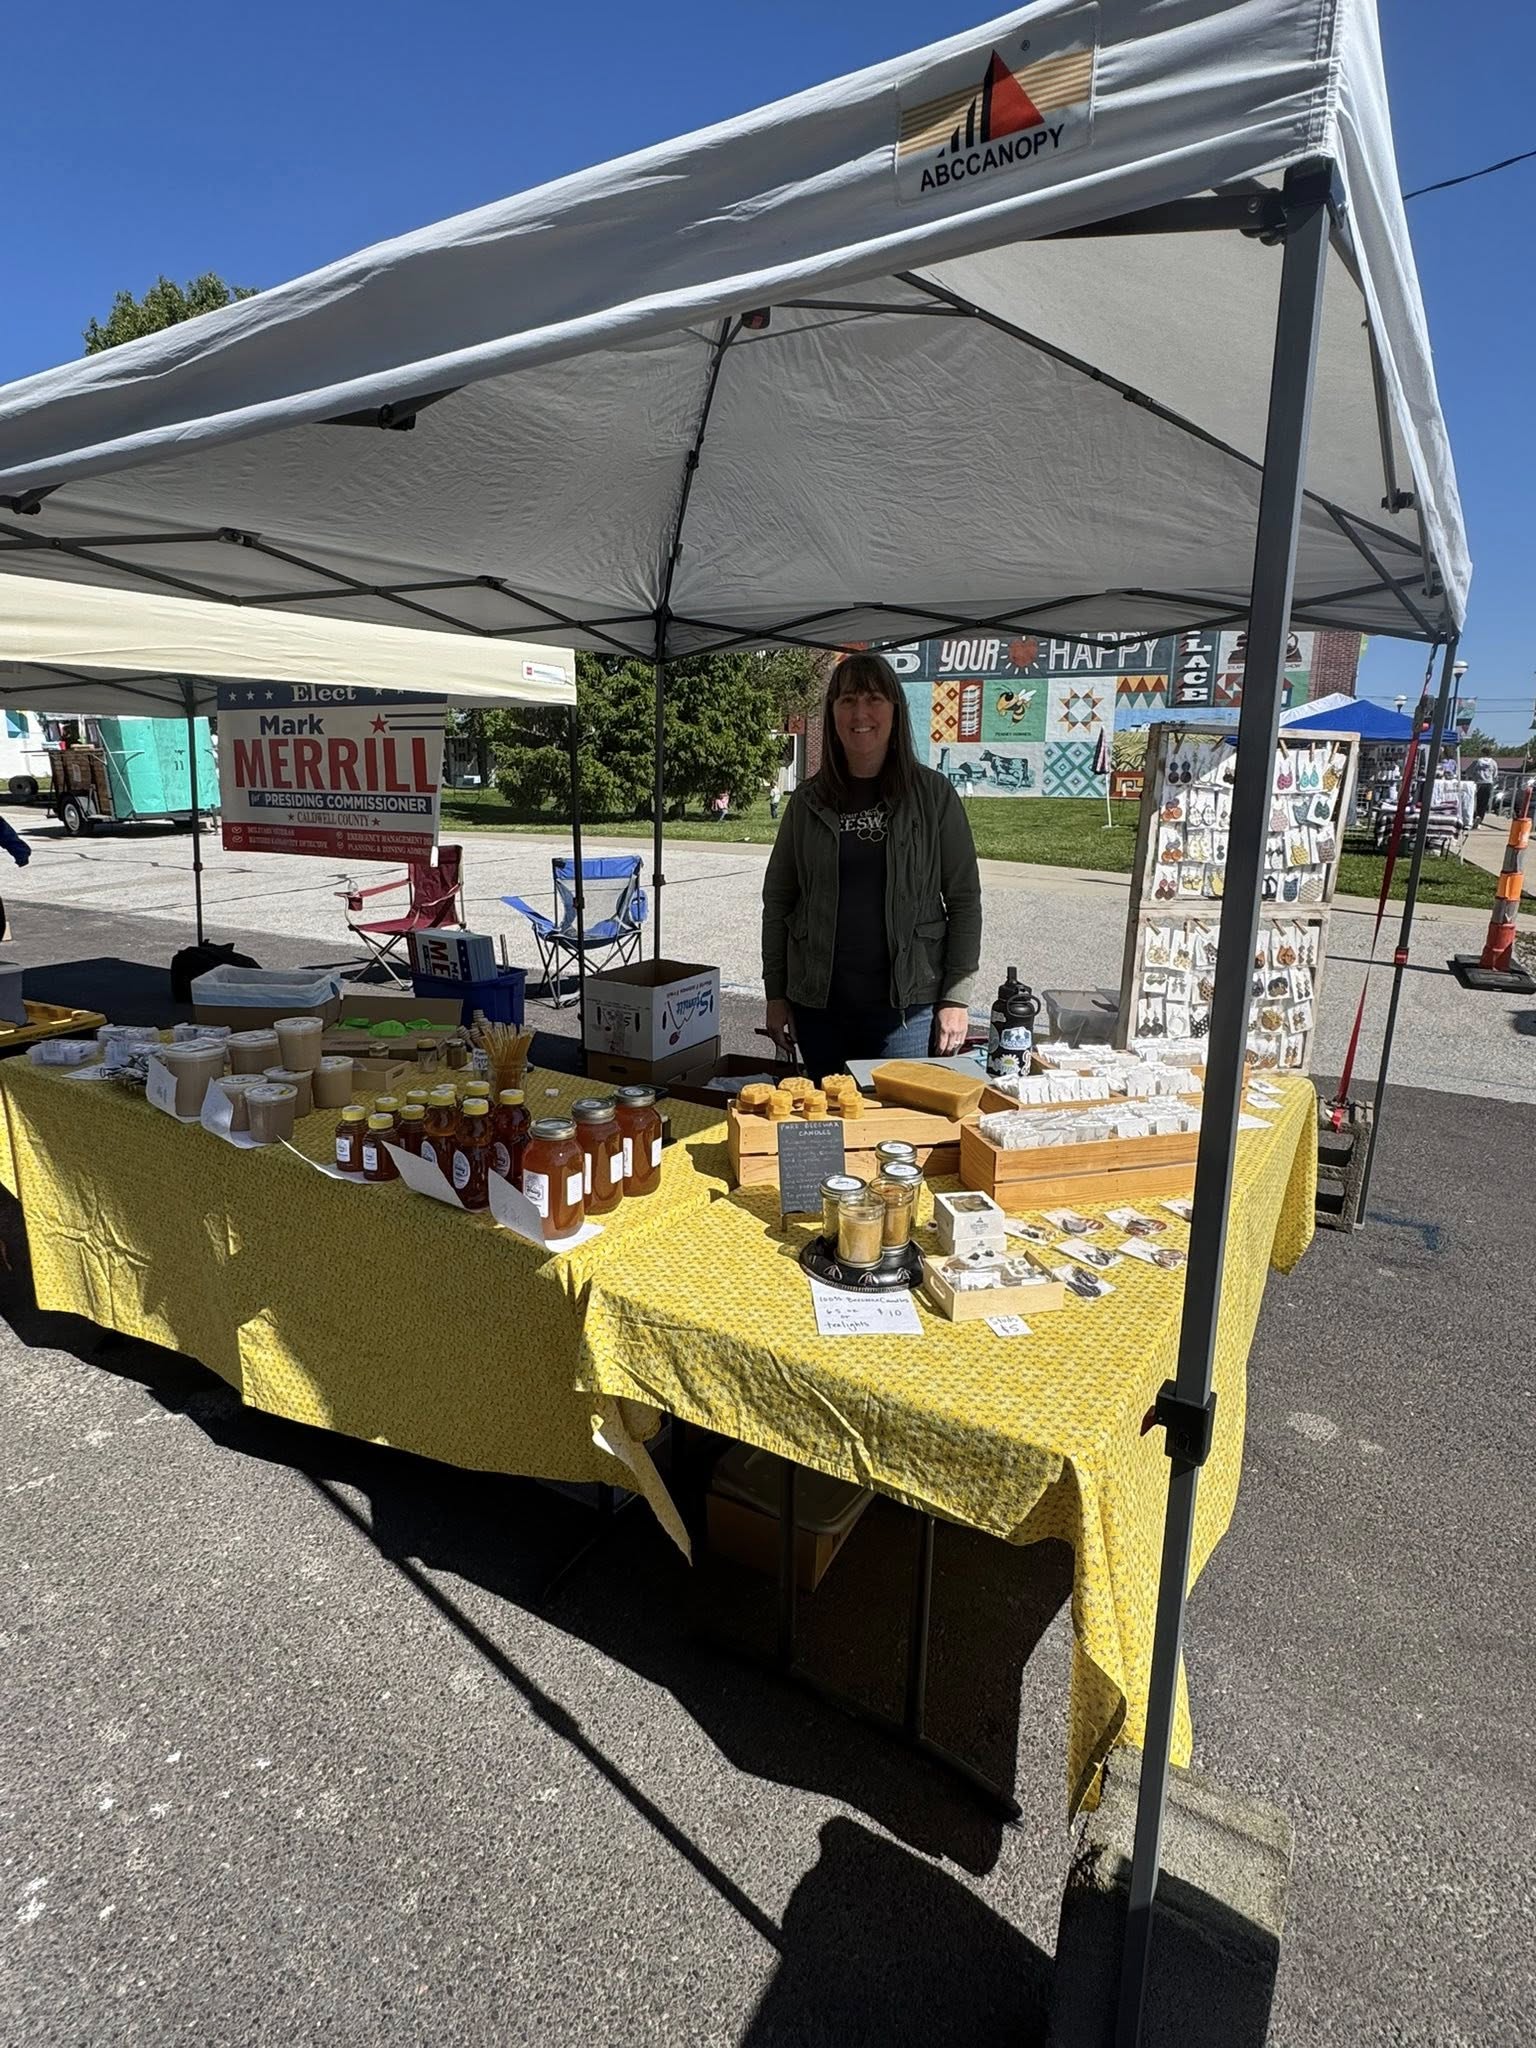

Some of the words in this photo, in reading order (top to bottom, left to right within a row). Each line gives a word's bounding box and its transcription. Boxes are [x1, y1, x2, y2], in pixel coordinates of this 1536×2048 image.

[920, 123, 1065, 192] ABCCANOPY
[938, 639, 1001, 673] YOUR
[1048, 631, 1160, 670] HAPPY
[290, 684, 357, 702] Elect
[259, 713, 325, 736] Mark
[233, 737, 438, 793] MERRILL
[265, 793, 324, 808] PRESIDING
[327, 795, 427, 813] COMMISSIONER
[297, 811, 337, 825] CALDWELL
[337, 813, 370, 827] COUNTY
[798, 1129, 832, 1137] CANDLES
[804, 1121, 841, 1130] BEESWAX
